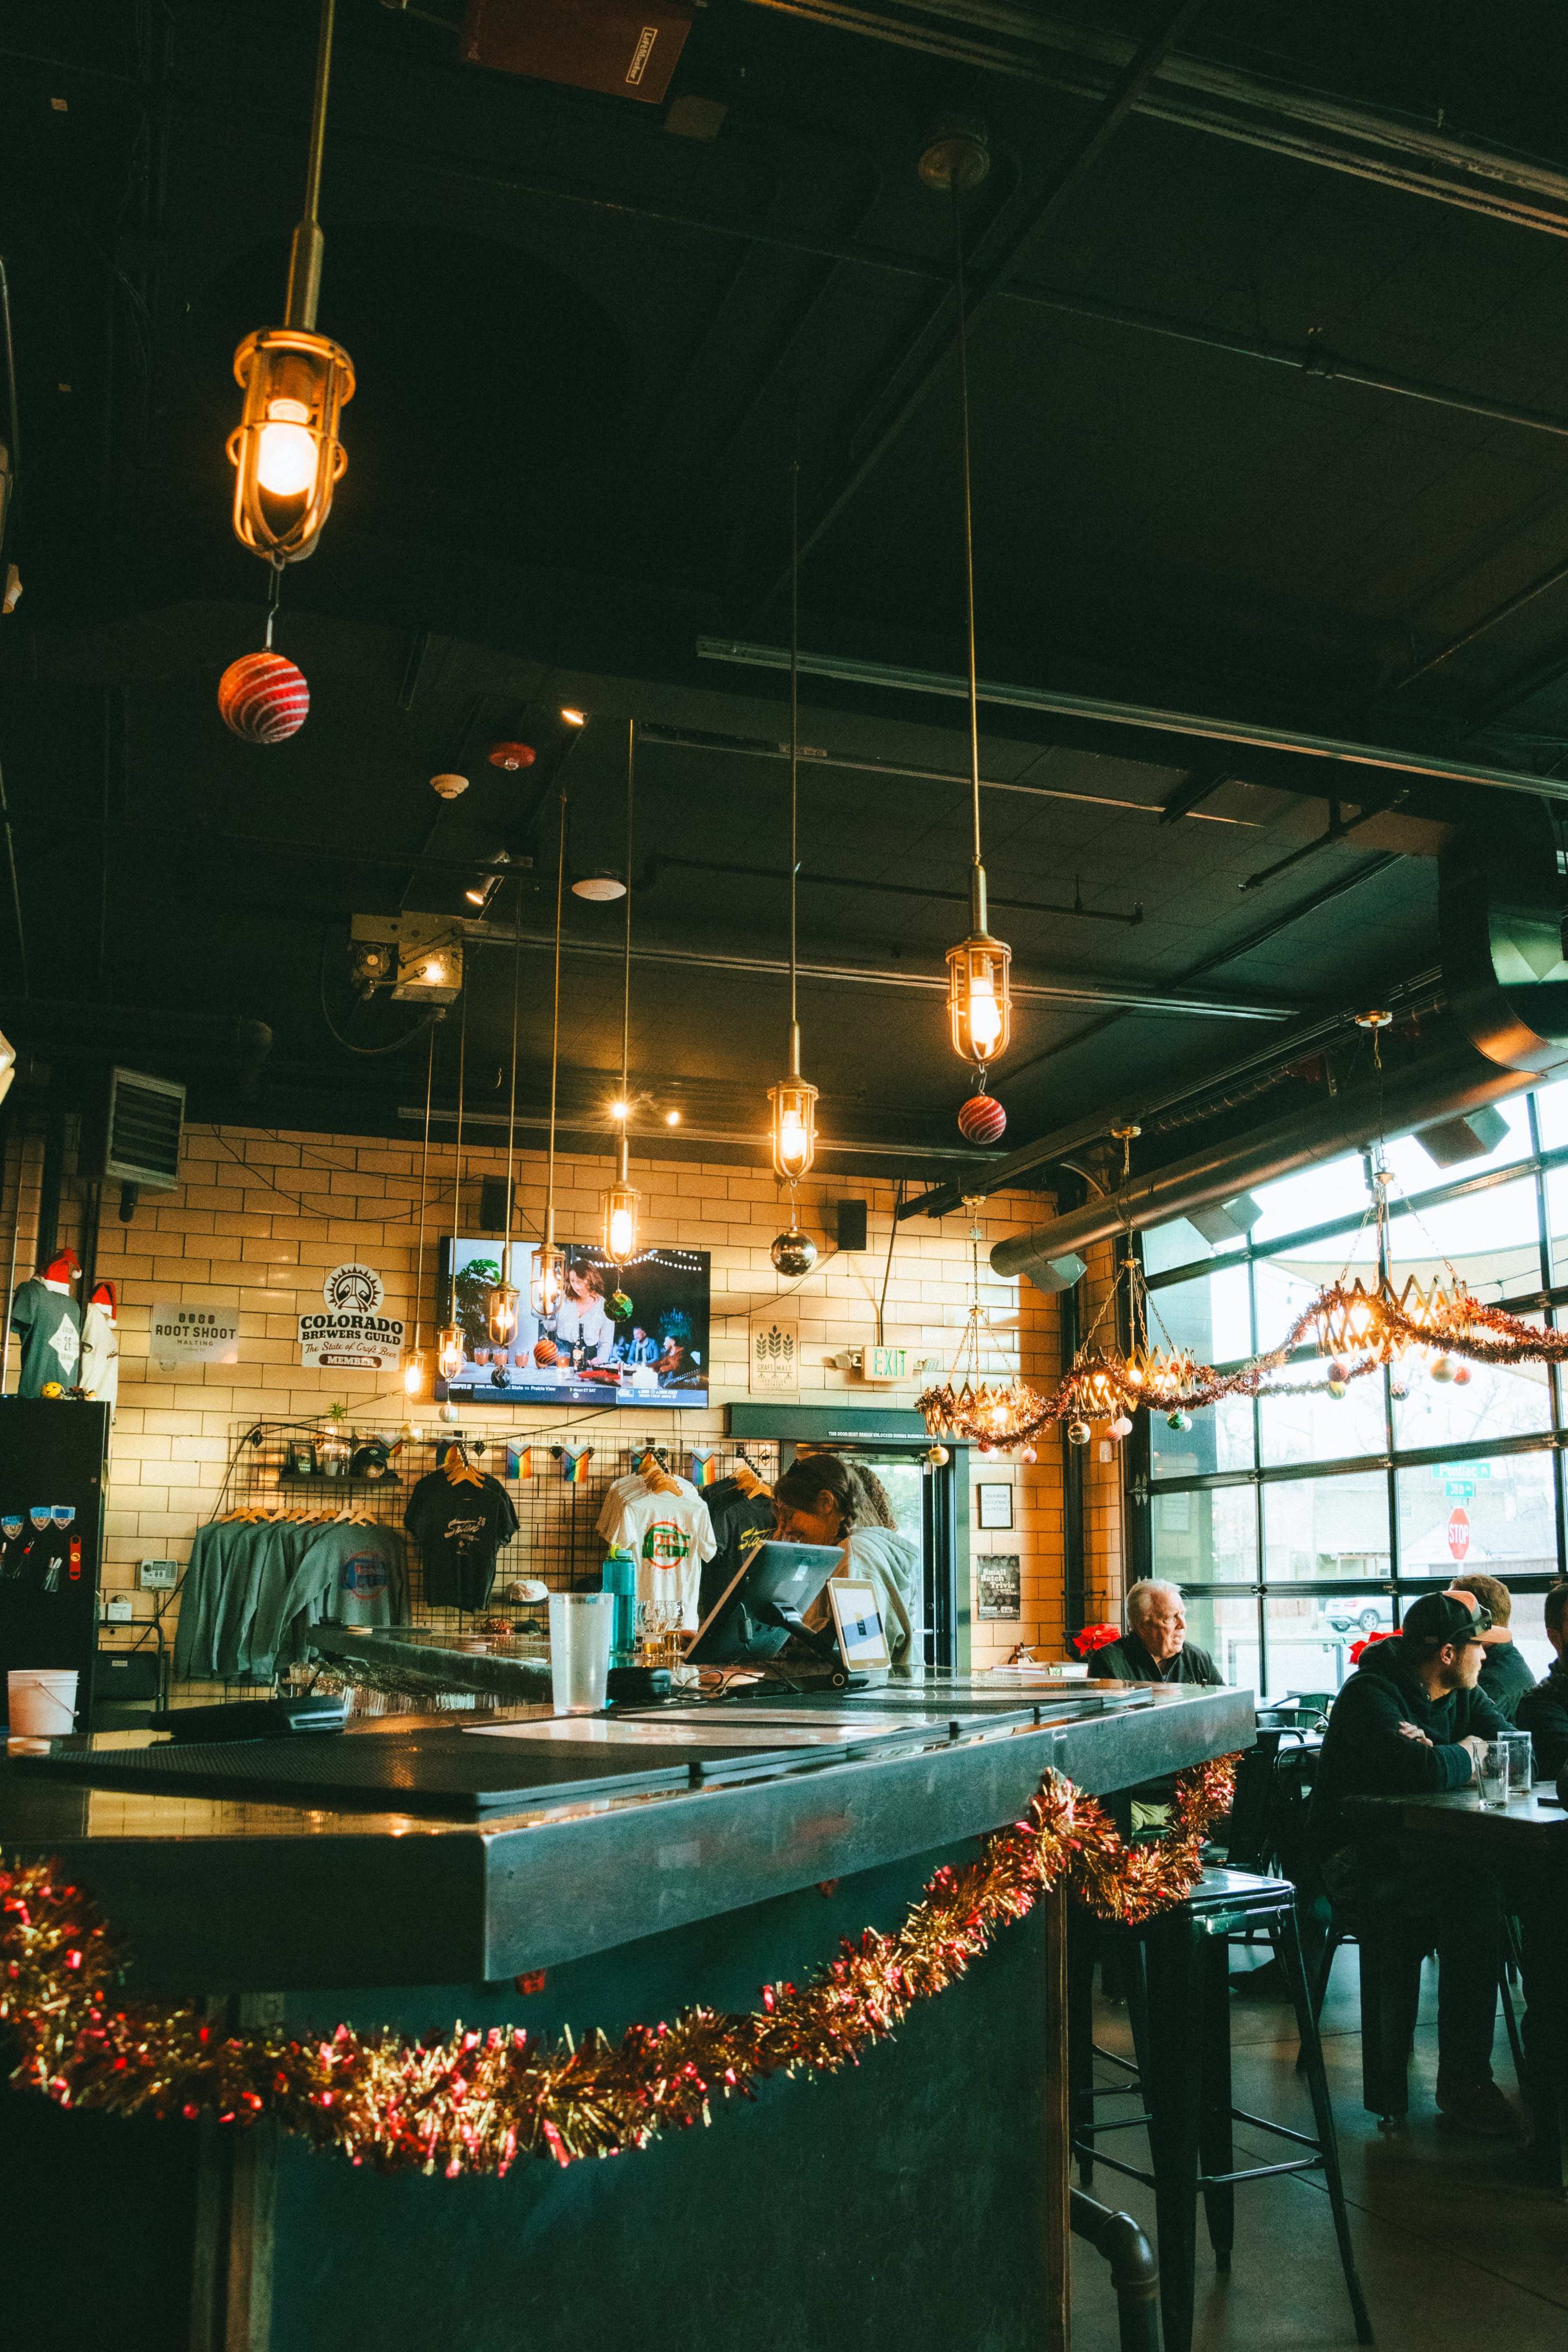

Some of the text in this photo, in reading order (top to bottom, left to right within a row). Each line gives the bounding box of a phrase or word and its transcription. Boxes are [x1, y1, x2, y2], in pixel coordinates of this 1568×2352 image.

[630, 32, 653, 79] LiftMaster
[156, 1325, 236, 1339] ROOT SHOOT
[301, 1314, 403, 1335] COLORADO
[302, 1330, 401, 1345] BREWERS GUILD
[305, 1341, 397, 1359] The State of Craft Beer
[327, 1356, 374, 1366] MEMBER
[873, 1348, 906, 1376] EXIT
[1439, 1464, 1477, 1477] Pontiac
[1449, 1524, 1469, 1544] STOP
[654, 1533, 678, 1557] 26
